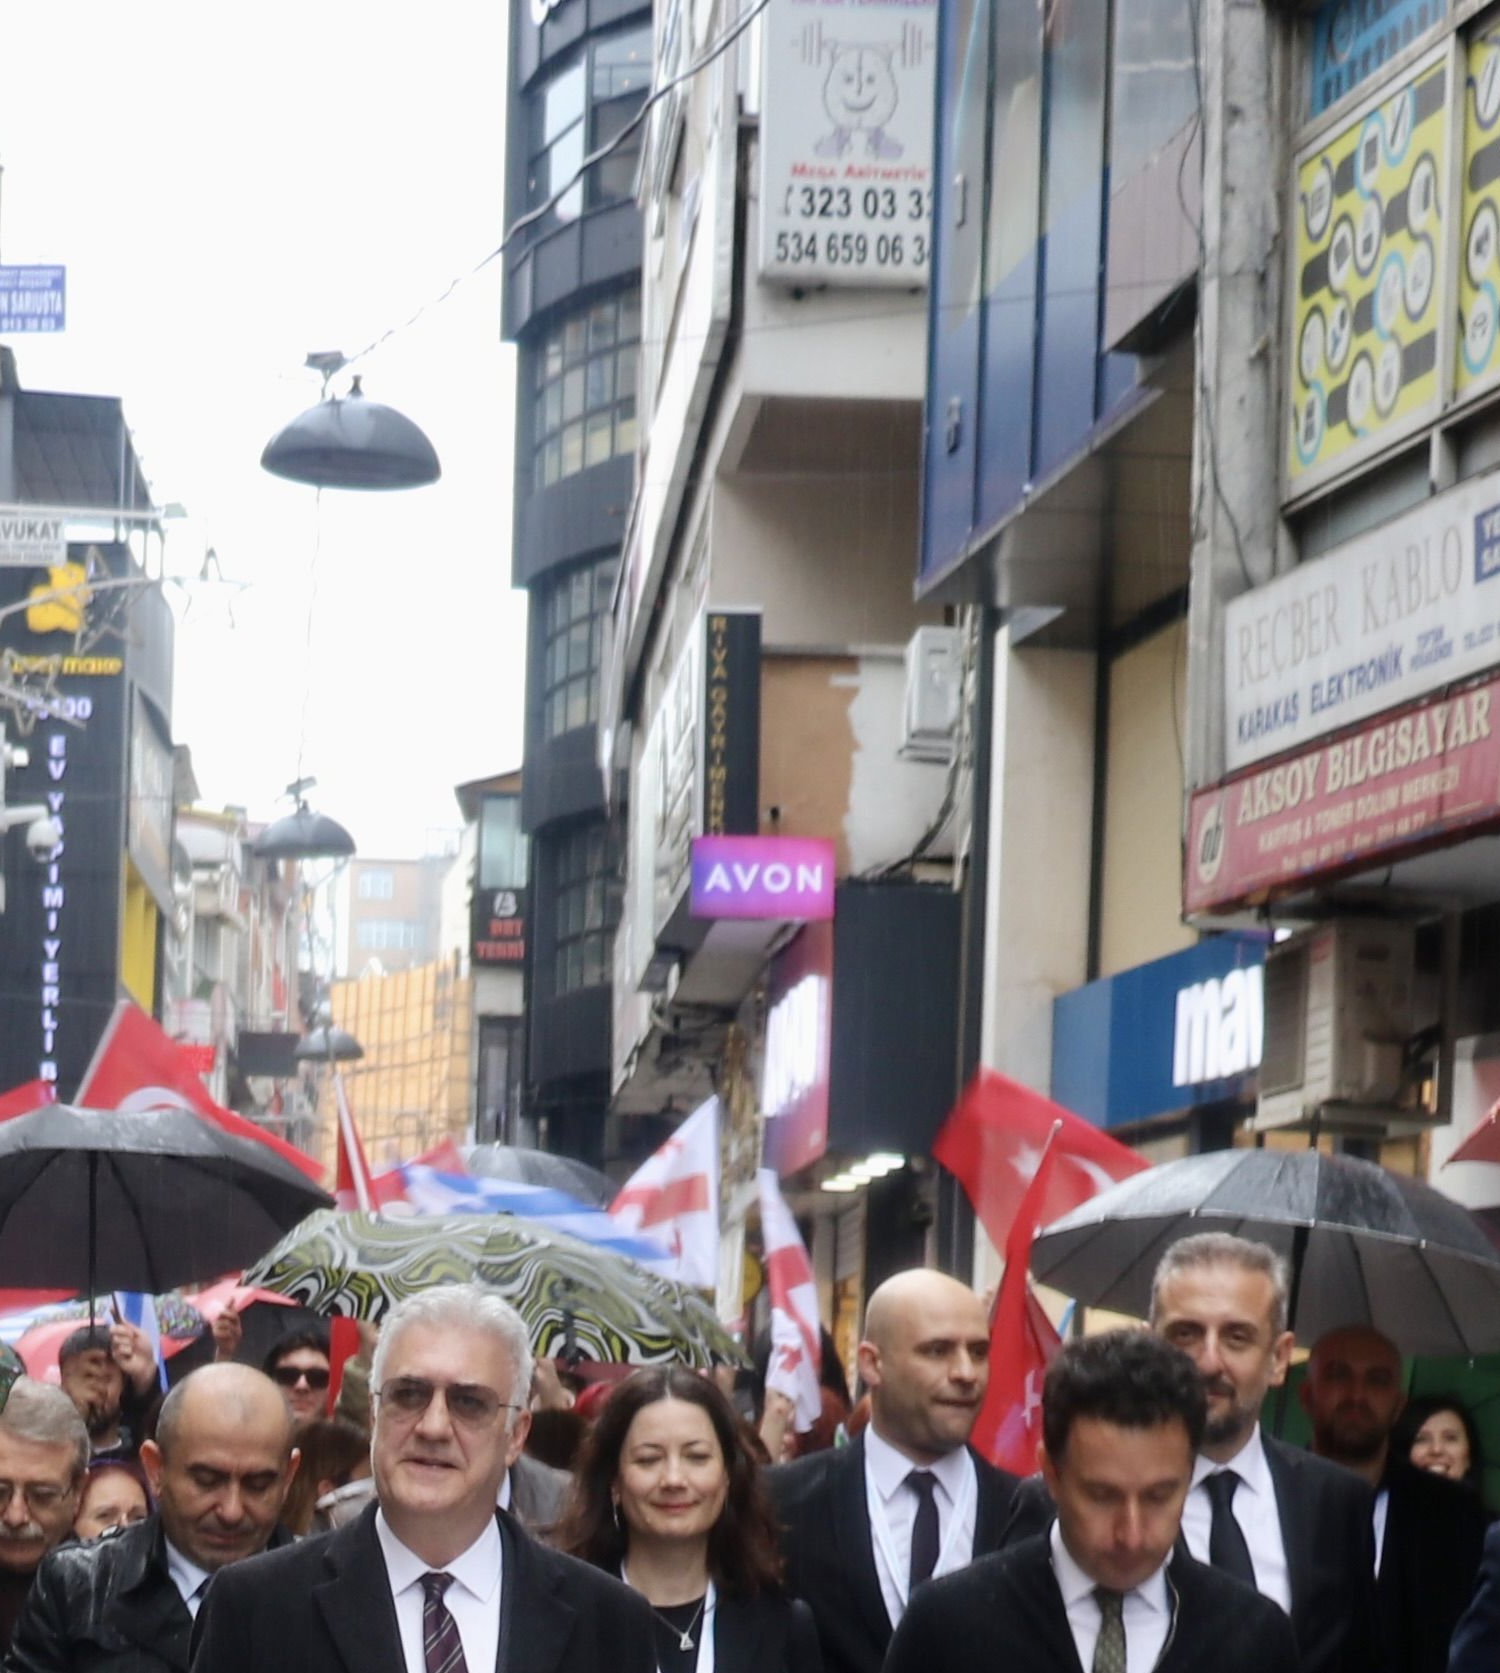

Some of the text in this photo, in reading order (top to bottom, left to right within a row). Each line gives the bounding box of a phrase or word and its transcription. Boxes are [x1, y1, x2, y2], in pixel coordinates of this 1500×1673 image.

[801, 187, 852, 219] 323
[863, 187, 897, 220] 03
[776, 231, 818, 264] 534
[826, 233, 868, 264] 659
[877, 235, 903, 266] 06
[1361, 525, 1464, 637] KABLO
[1310, 644, 1403, 717] ELEKTRONİK
[1236, 751, 1322, 826] AKSOY
[703, 863, 823, 893] AVON
